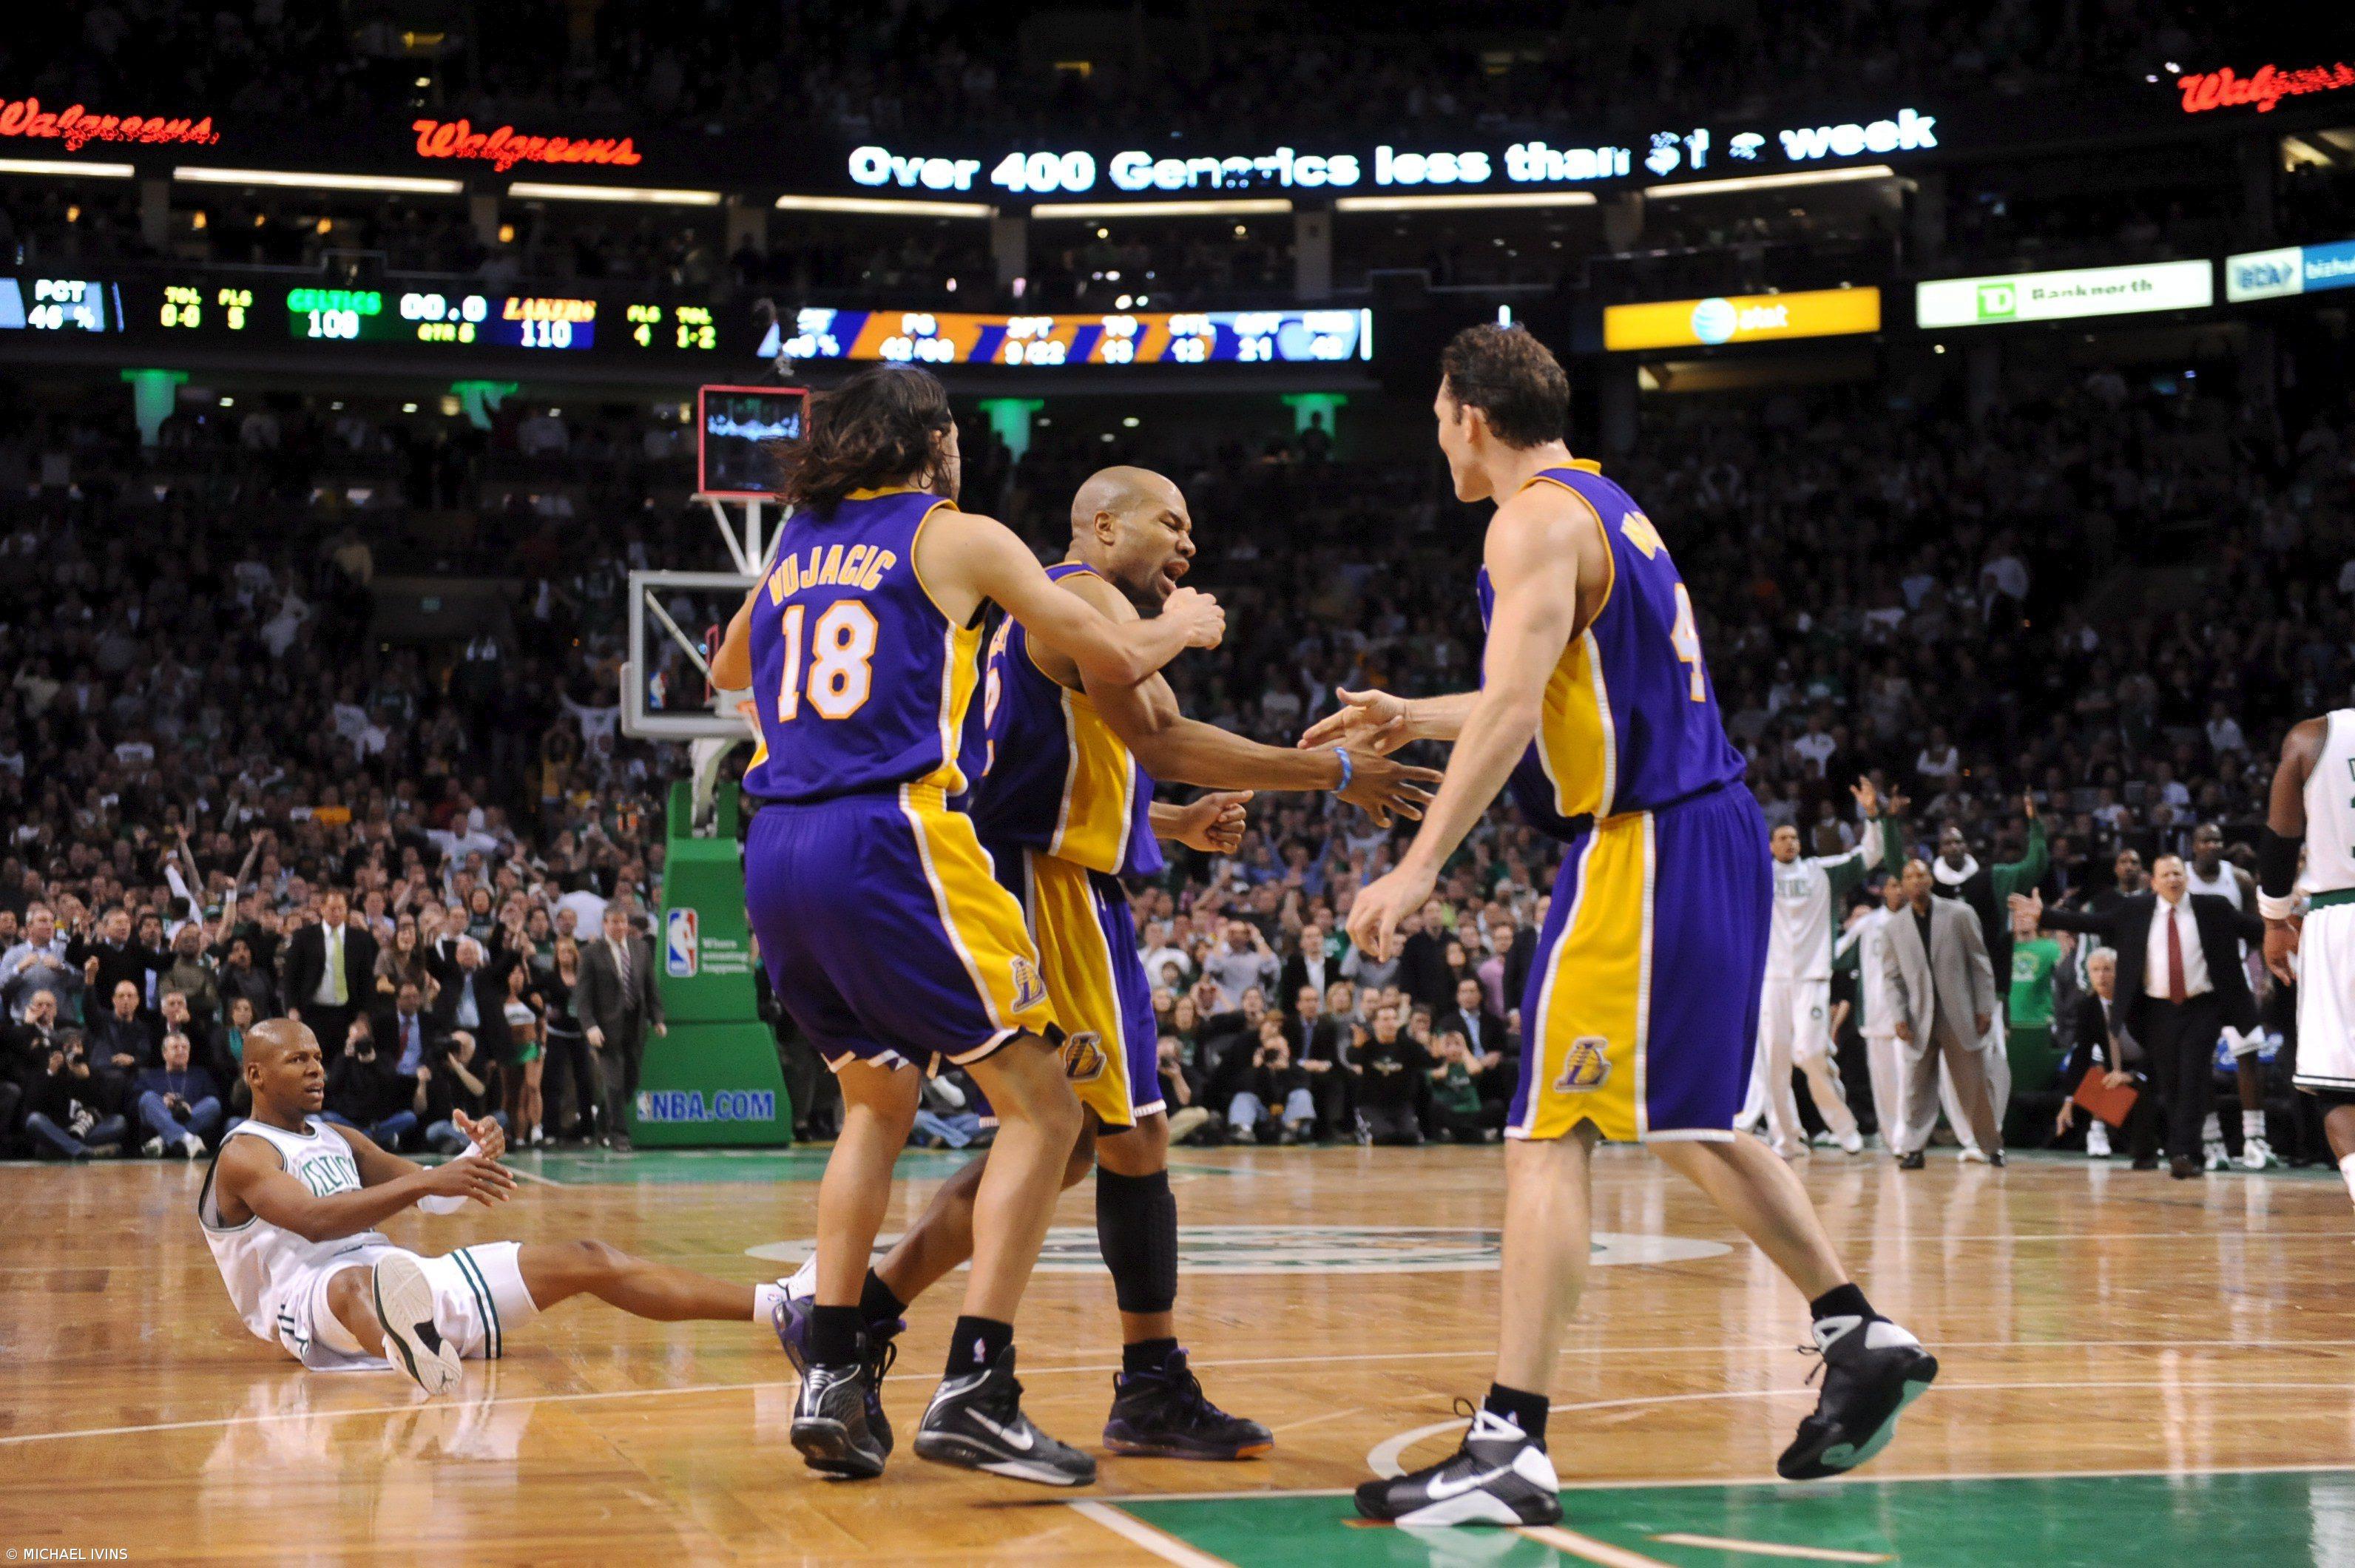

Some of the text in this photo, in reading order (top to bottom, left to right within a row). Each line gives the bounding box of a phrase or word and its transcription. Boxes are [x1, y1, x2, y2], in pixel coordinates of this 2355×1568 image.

[413, 119, 642, 172] Walgreens
[849, 146, 980, 190] Over
[991, 151, 1096, 192] 400
[1375, 145, 1491, 185] less
[1504, 141, 1630, 182] than
[1780, 108, 1938, 160] week
[521, 318, 572, 348] 110
[634, 323, 651, 347] 4
[768, 544, 897, 606] VUJACIC
[777, 600, 879, 723] 18
[652, 1091, 774, 1121] NBA.COM
